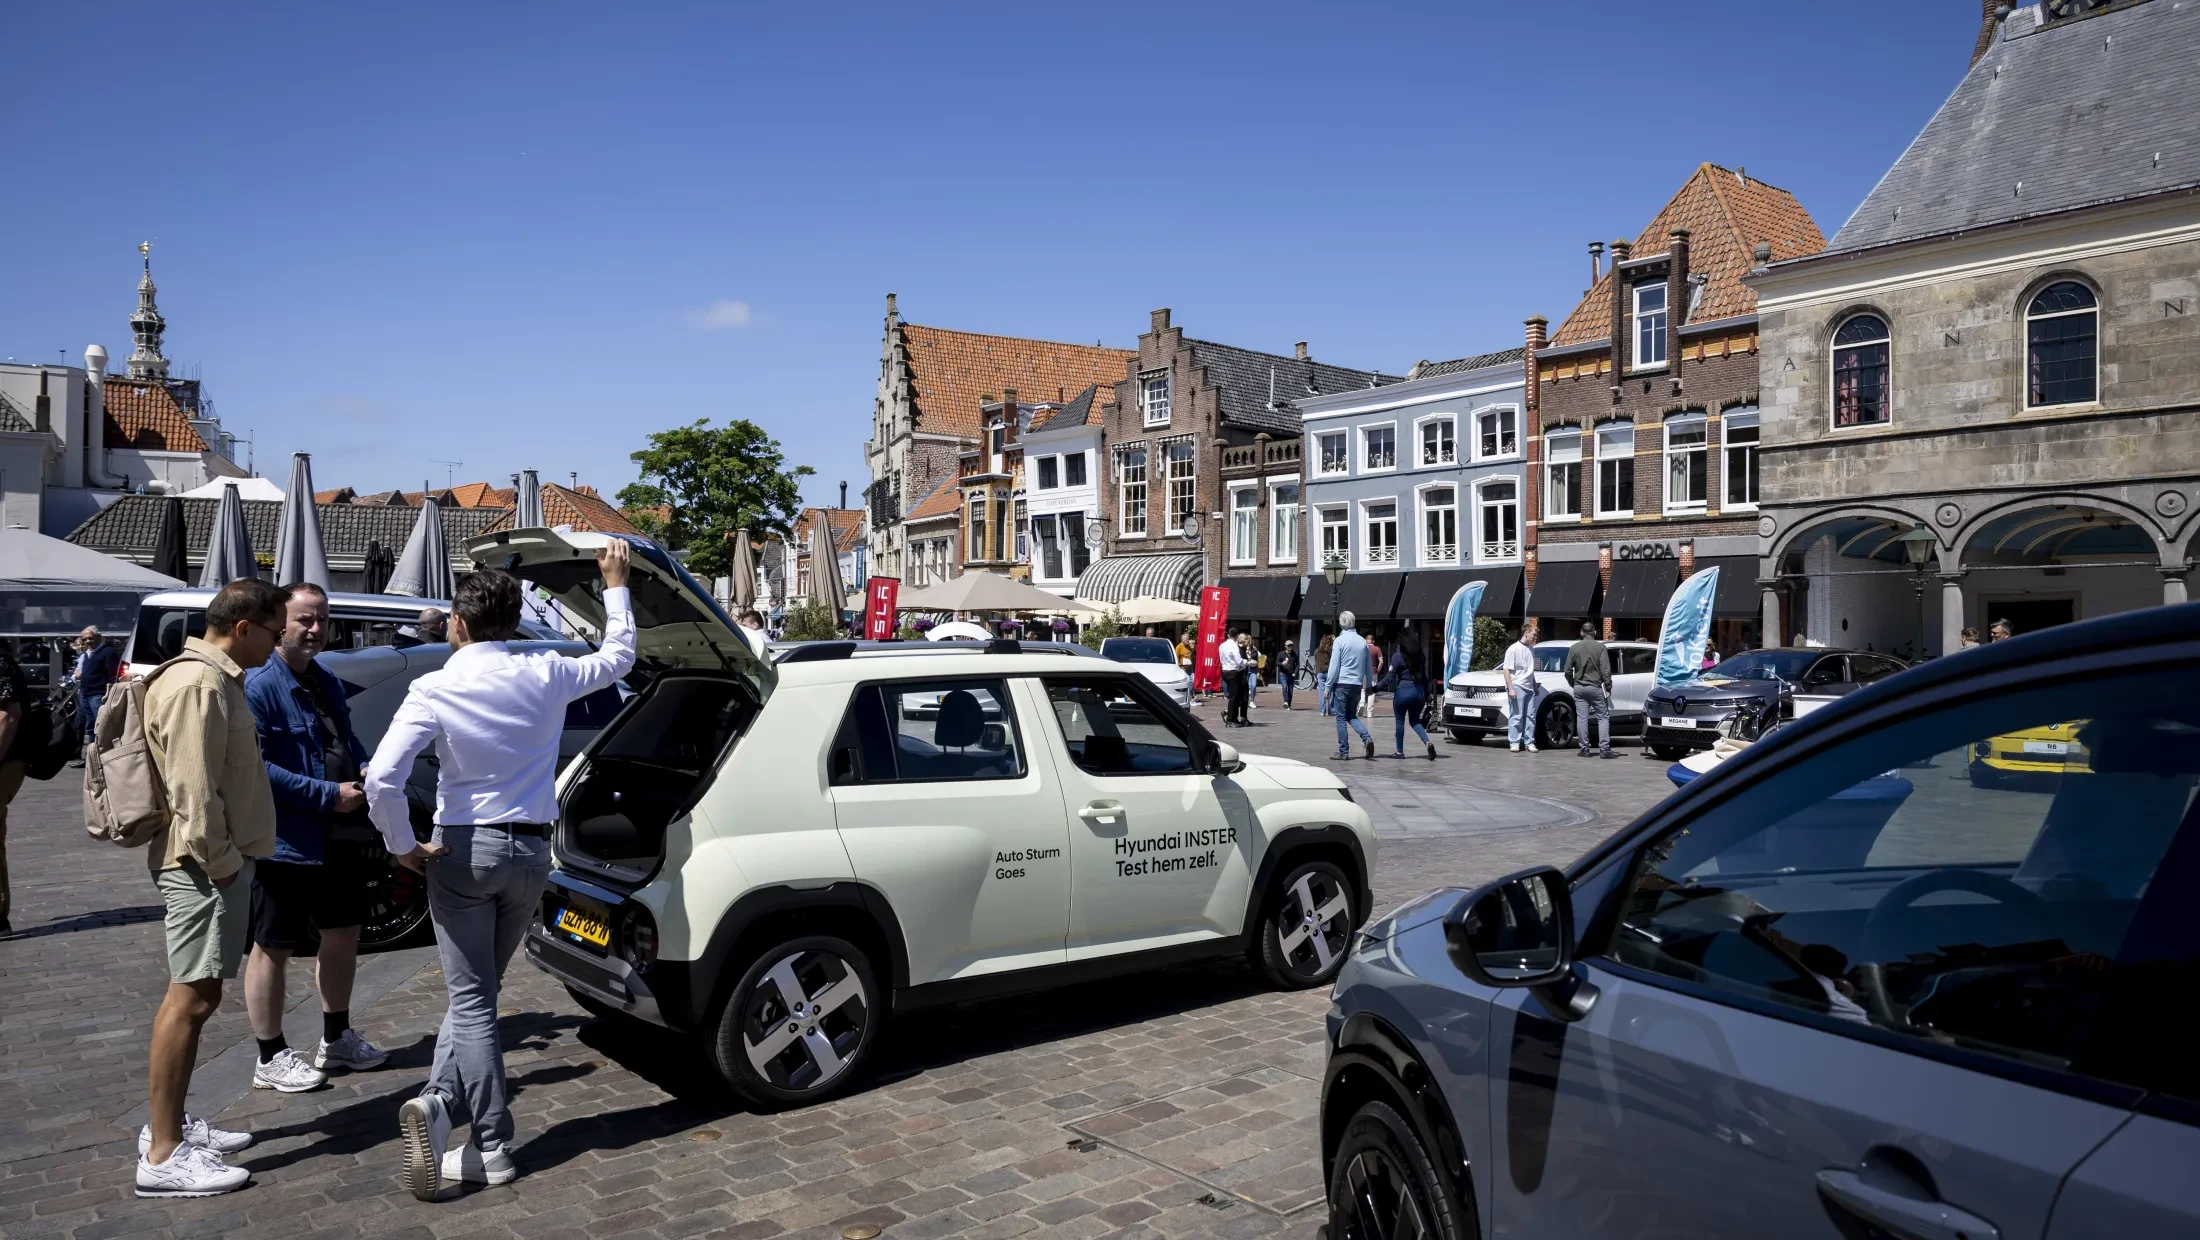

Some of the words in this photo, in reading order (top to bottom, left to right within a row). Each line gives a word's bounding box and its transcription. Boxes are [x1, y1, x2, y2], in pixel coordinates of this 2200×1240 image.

[1944, 331, 1960, 347] N
[2165, 299, 2184, 318] N
[1619, 543, 1675, 561] OMODA
[875, 586, 890, 640] SLA
[1202, 591, 1221, 688] TESLA
[995, 851, 1024, 863] Auto
[1025, 847, 1060, 861] Sturm
[1115, 833, 1182, 858] Hyundai
[1185, 827, 1237, 848] INSTER
[995, 867, 1026, 880] Goes
[1115, 858, 1148, 878] Test
[1152, 854, 1186, 874] hem
[1189, 850, 1218, 870] zelf.
